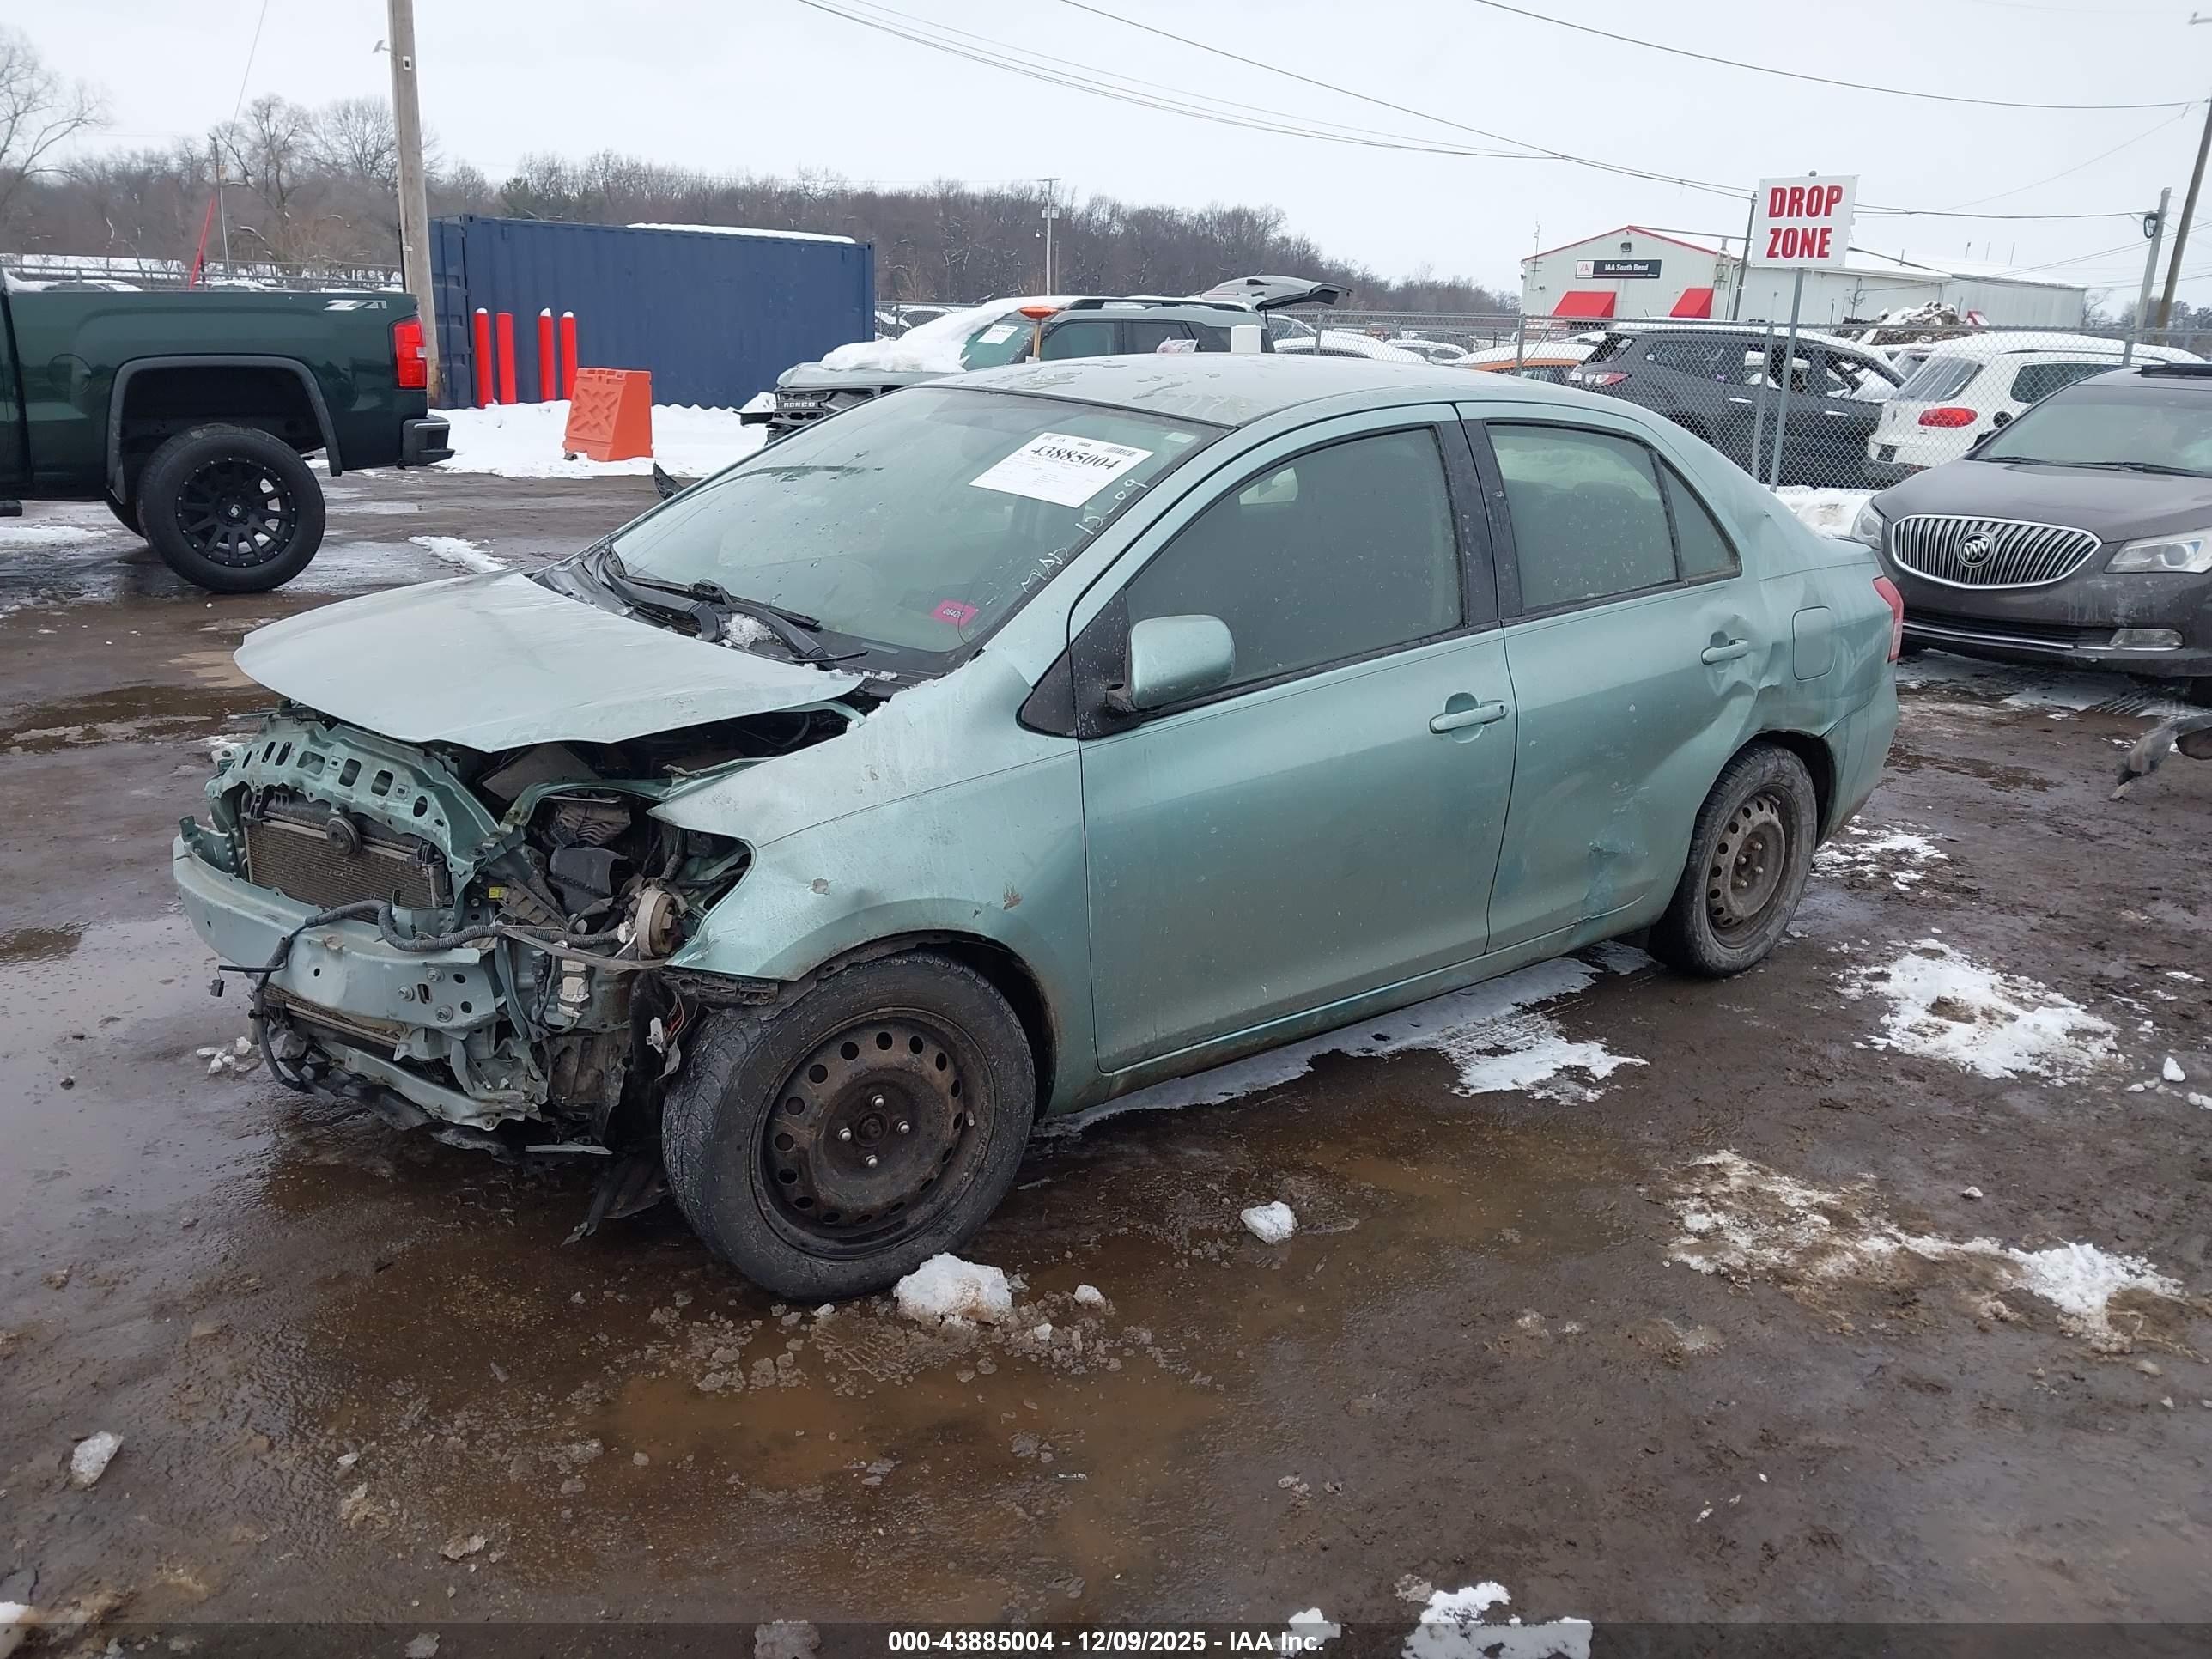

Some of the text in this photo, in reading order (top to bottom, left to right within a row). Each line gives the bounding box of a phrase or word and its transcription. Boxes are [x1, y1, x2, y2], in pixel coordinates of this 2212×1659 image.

[1768, 185, 1844, 218] DROP
[1766, 227, 1833, 258] ZONE
[323, 299, 387, 311] Z71
[1030, 444, 1121, 470] 43885004
